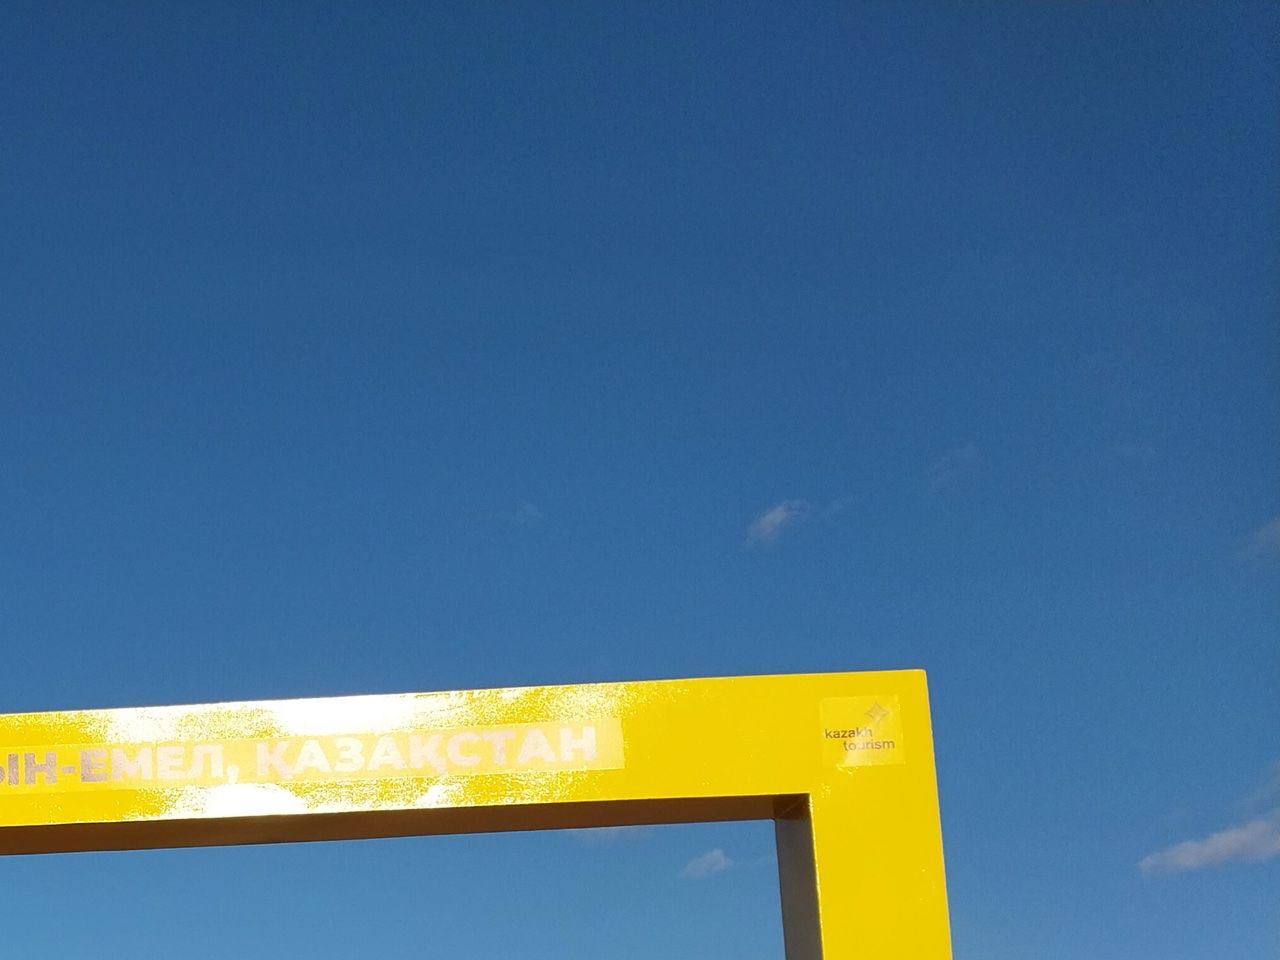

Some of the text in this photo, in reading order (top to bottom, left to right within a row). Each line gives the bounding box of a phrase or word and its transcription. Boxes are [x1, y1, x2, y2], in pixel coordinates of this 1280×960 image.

[825, 726, 873, 739] kazakh
[843, 739, 895, 751] tourism
[256, 726, 598, 781] ҚАЗАҚСТАН
